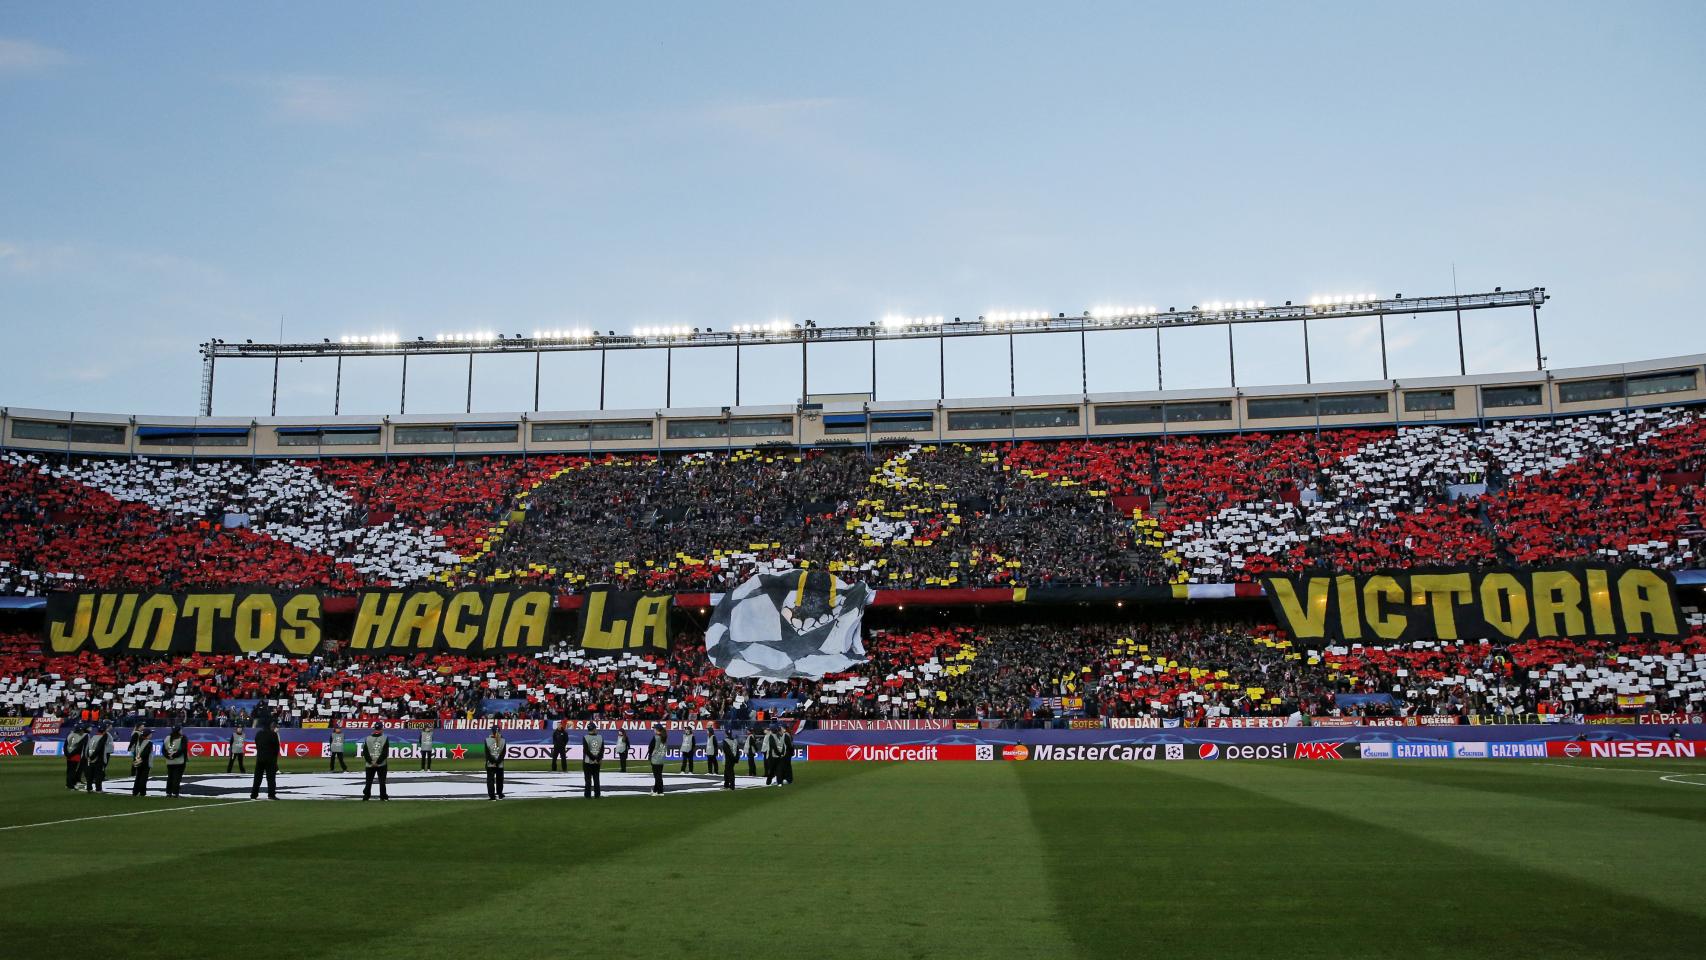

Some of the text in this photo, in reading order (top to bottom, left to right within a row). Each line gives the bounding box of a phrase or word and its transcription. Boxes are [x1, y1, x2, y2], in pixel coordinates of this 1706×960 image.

[1267, 568, 1679, 640] VICTORIA
[50, 591, 672, 655] JUNTOS HACIA LA
[345, 720, 369, 729] ESTE
[621, 720, 647, 731] ANA
[876, 719, 941, 731] CANILLAS
[1207, 717, 1285, 729] FABERO
[210, 743, 289, 757] NISN
[863, 746, 938, 761] UniCredit
[1033, 744, 1157, 761] MasterCard
[1226, 742, 1344, 761] pepsi MAX
[1397, 744, 1449, 758] GAZPROM
[1491, 743, 1545, 758] GAZPROM
[1590, 742, 1696, 758] NISSAN
